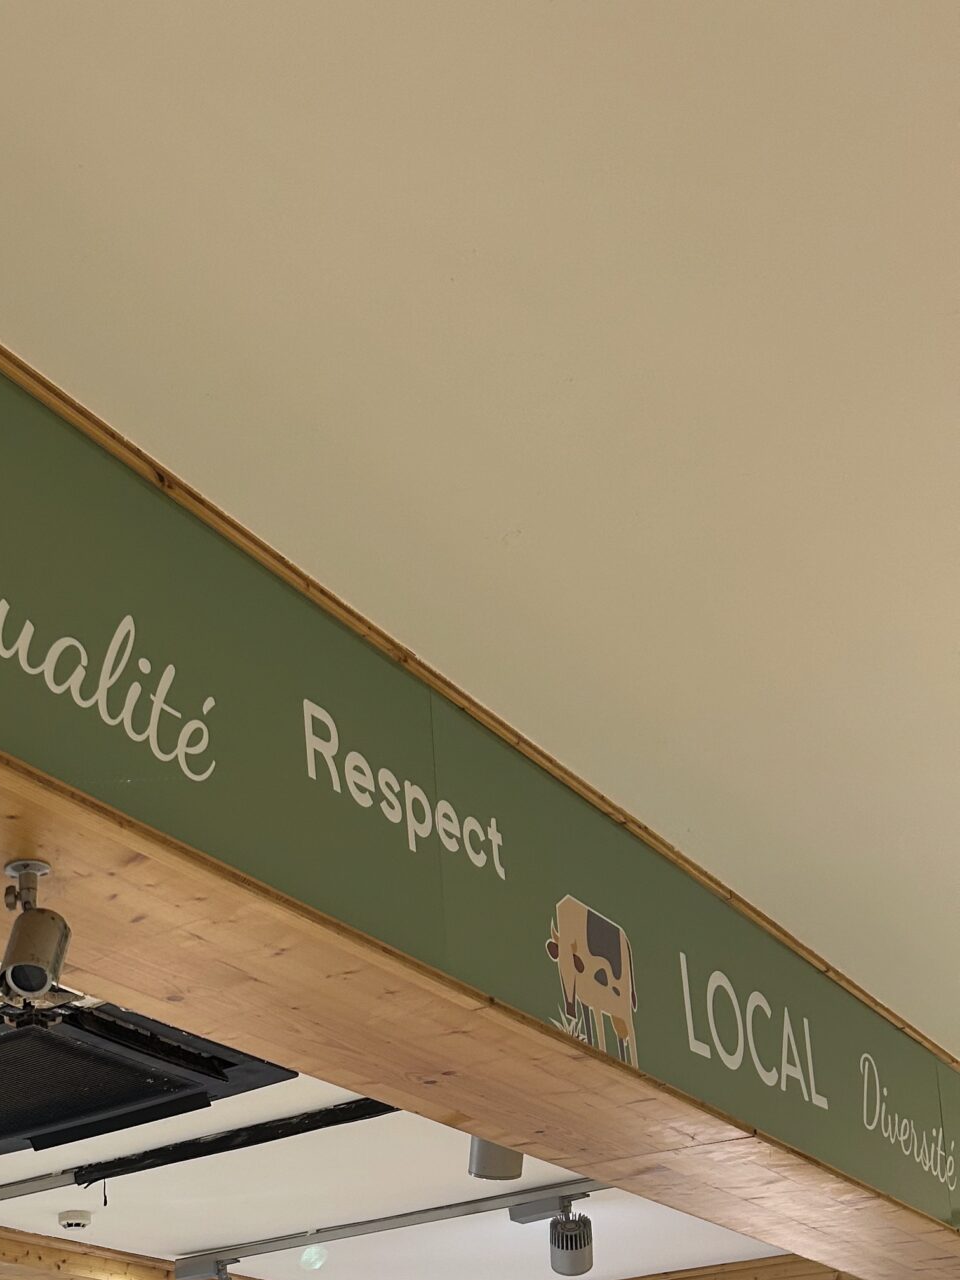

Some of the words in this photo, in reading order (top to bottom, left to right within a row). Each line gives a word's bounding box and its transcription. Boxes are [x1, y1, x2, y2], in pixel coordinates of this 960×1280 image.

[303, 698, 506, 880] Respect
[679, 951, 829, 1110] LOCAL
[860, 1052, 957, 1191] Diversité
